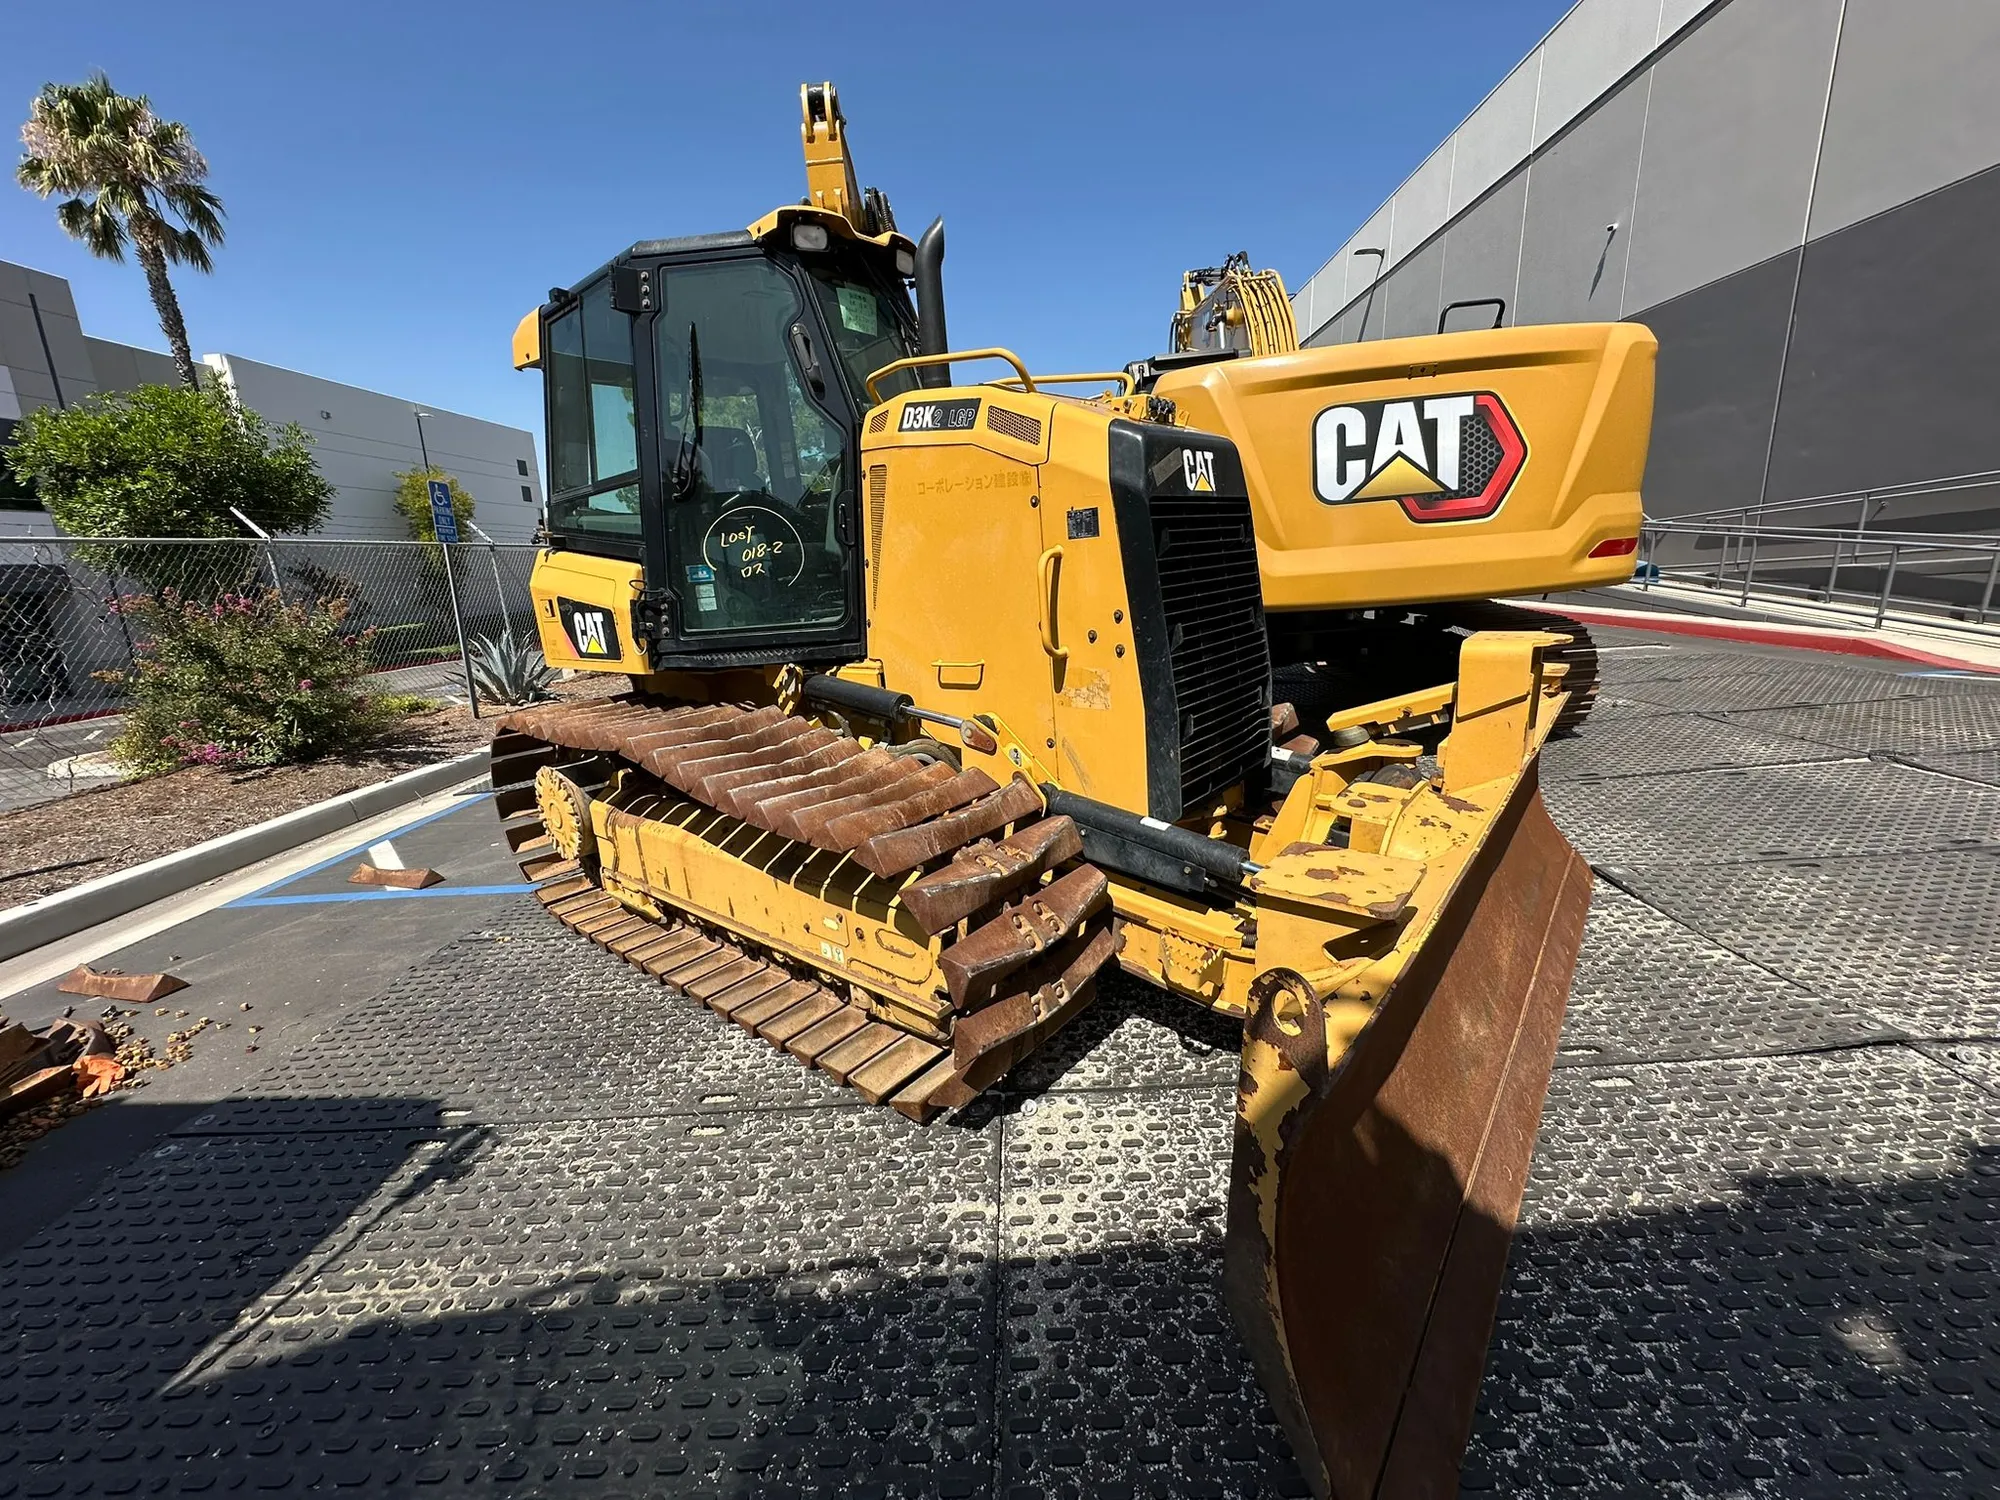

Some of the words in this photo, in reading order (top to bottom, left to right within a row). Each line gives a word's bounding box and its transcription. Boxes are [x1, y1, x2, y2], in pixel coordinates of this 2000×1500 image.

[948, 408, 976, 428] LGP
[1182, 448, 1216, 492] CAT
[1316, 396, 1475, 501] CAT
[573, 611, 608, 654] CAT
